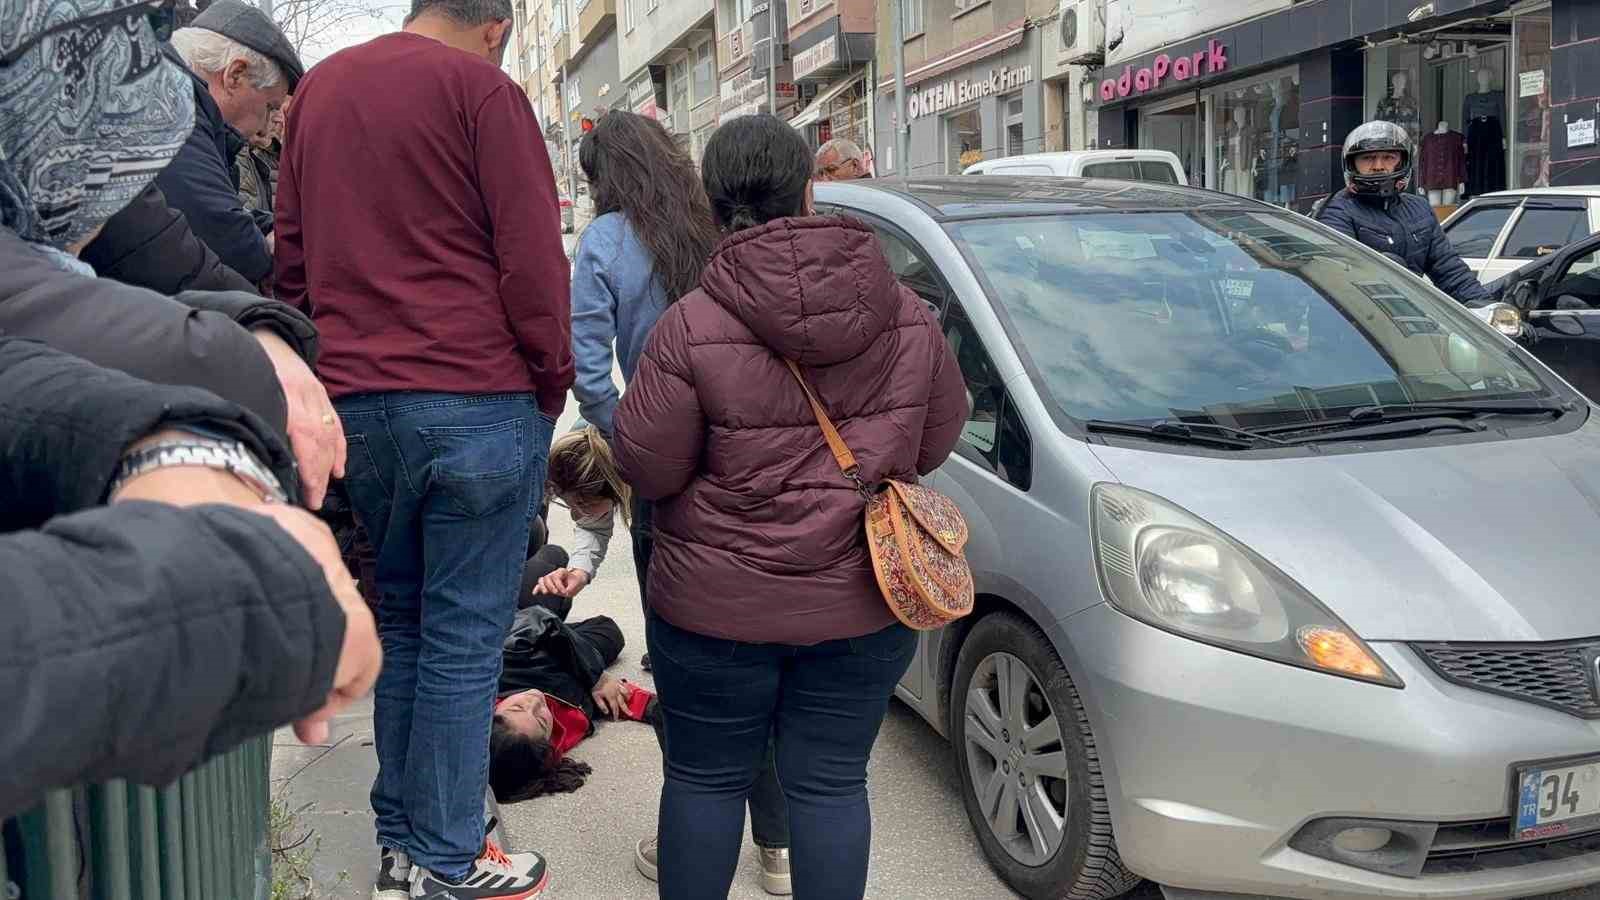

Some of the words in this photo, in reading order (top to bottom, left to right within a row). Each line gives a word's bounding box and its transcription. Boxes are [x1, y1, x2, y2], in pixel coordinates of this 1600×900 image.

[909, 80, 955, 118] ÖKTEM
[959, 70, 997, 104] Ekmek
[1521, 803, 1537, 816] TR
[1540, 772, 1579, 817] 34
